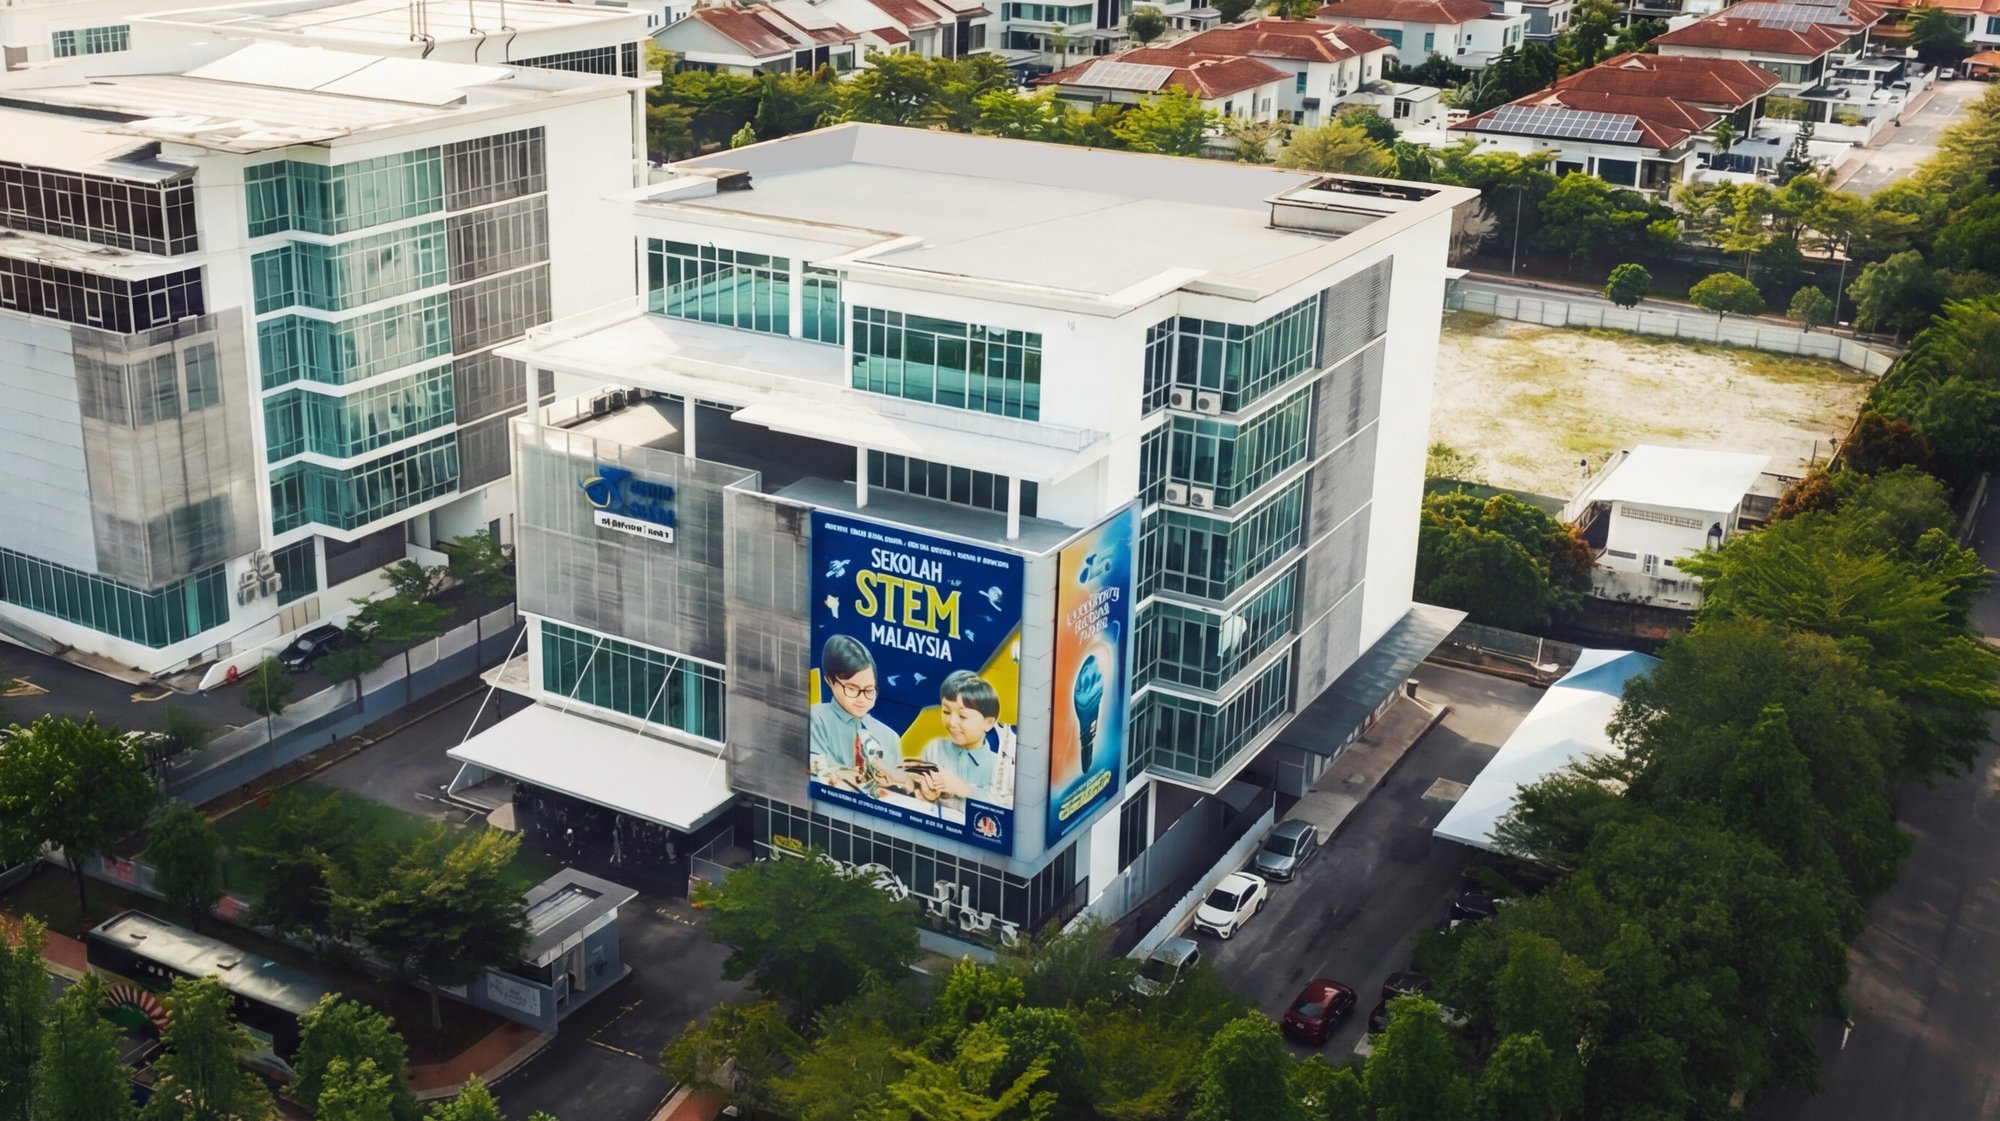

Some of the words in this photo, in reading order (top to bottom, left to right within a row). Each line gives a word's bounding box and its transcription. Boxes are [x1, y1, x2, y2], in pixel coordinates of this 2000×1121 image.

[871, 547, 943, 584] SEKOLAH
[855, 569, 962, 640] STEM
[871, 622, 952, 662] MALAYSIA
